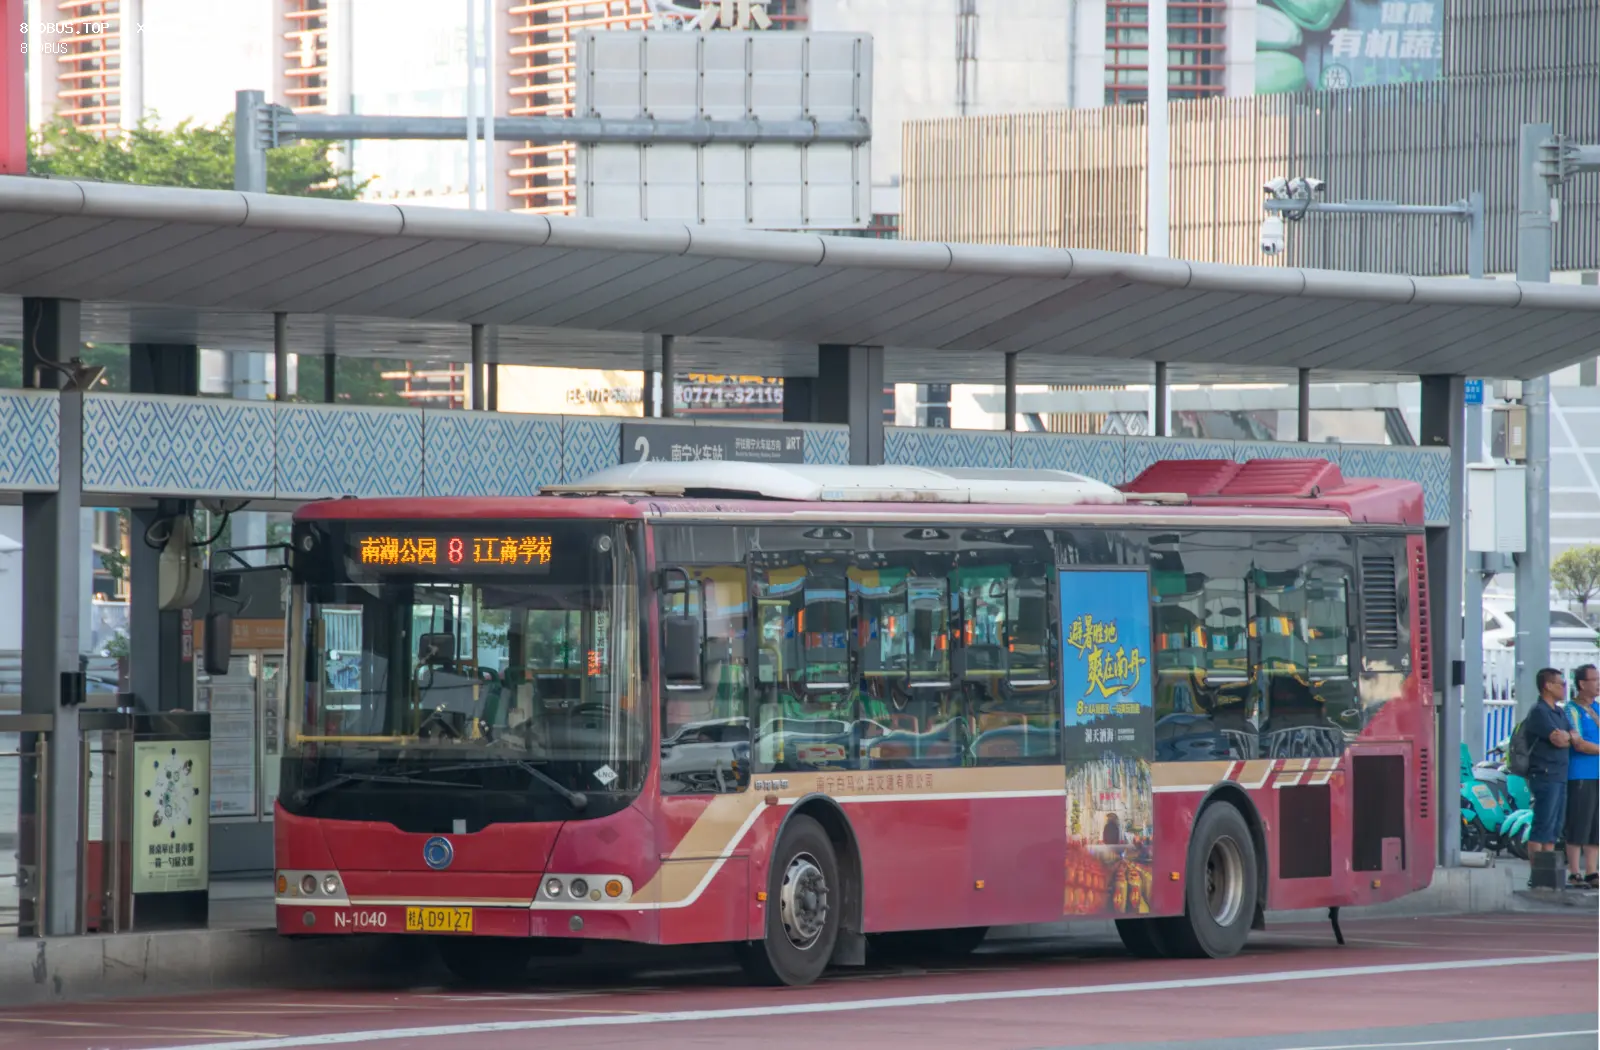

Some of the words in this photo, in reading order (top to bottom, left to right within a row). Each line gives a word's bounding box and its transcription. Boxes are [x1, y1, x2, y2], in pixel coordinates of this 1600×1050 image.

[1330, 28, 1443, 59] 有机蔬
[671, 444, 723, 462] 南宁火车站
[360, 536, 437, 565] 南湖公园
[448, 537, 464, 564] 8
[1067, 614, 1118, 659] 避暑胜地
[1084, 644, 1147, 698] 爽在南丹
[816, 773, 933, 793] 南宁白马公共交通有限公司
[334, 911, 387, 927] N-1040
